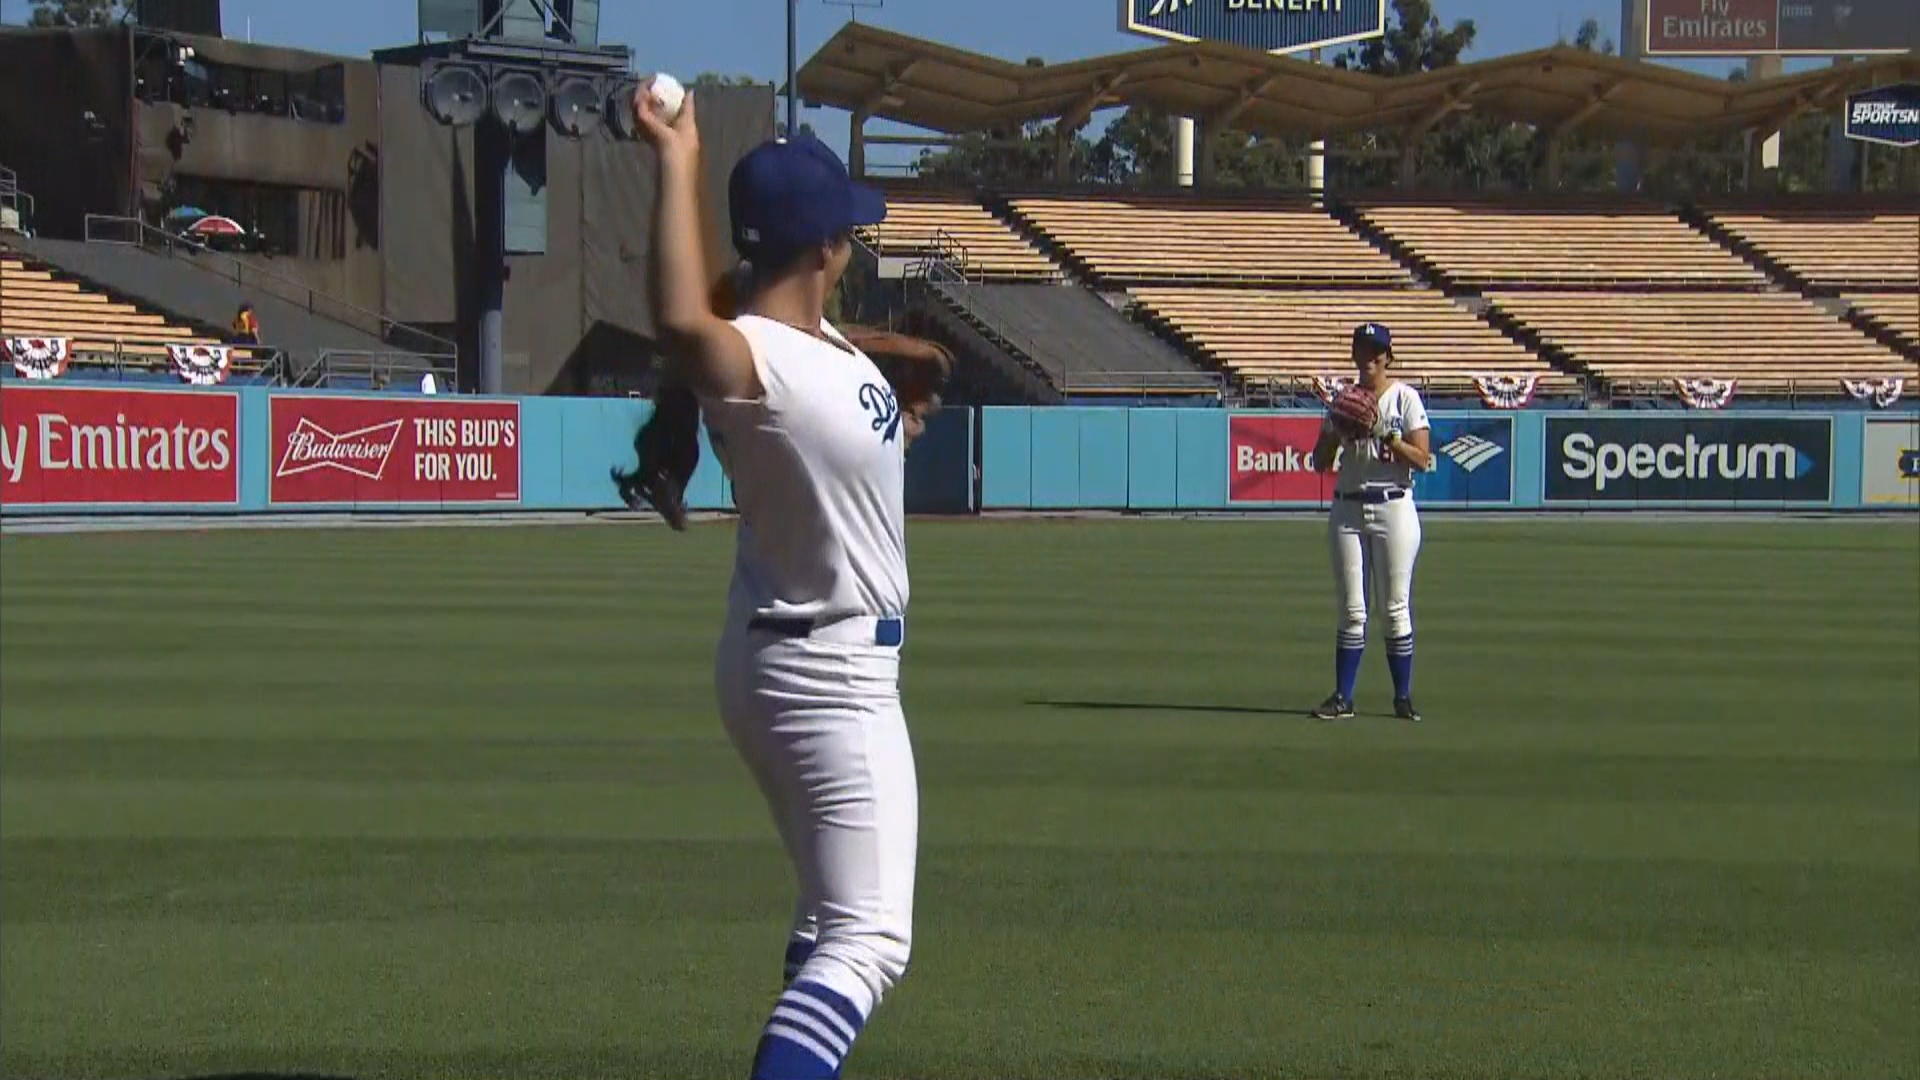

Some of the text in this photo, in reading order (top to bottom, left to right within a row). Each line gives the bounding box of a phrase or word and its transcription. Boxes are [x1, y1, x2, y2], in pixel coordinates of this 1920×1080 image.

[1663, 16, 1767, 38] Emirates
[38, 412, 230, 470] Emirates
[287, 431, 389, 461] Budweiser
[414, 418, 515, 447] THIS BUD'S
[415, 453, 497, 480] FOR YOU.
[1237, 445, 1300, 472] Bank
[1562, 433, 1797, 490] Spectrum
